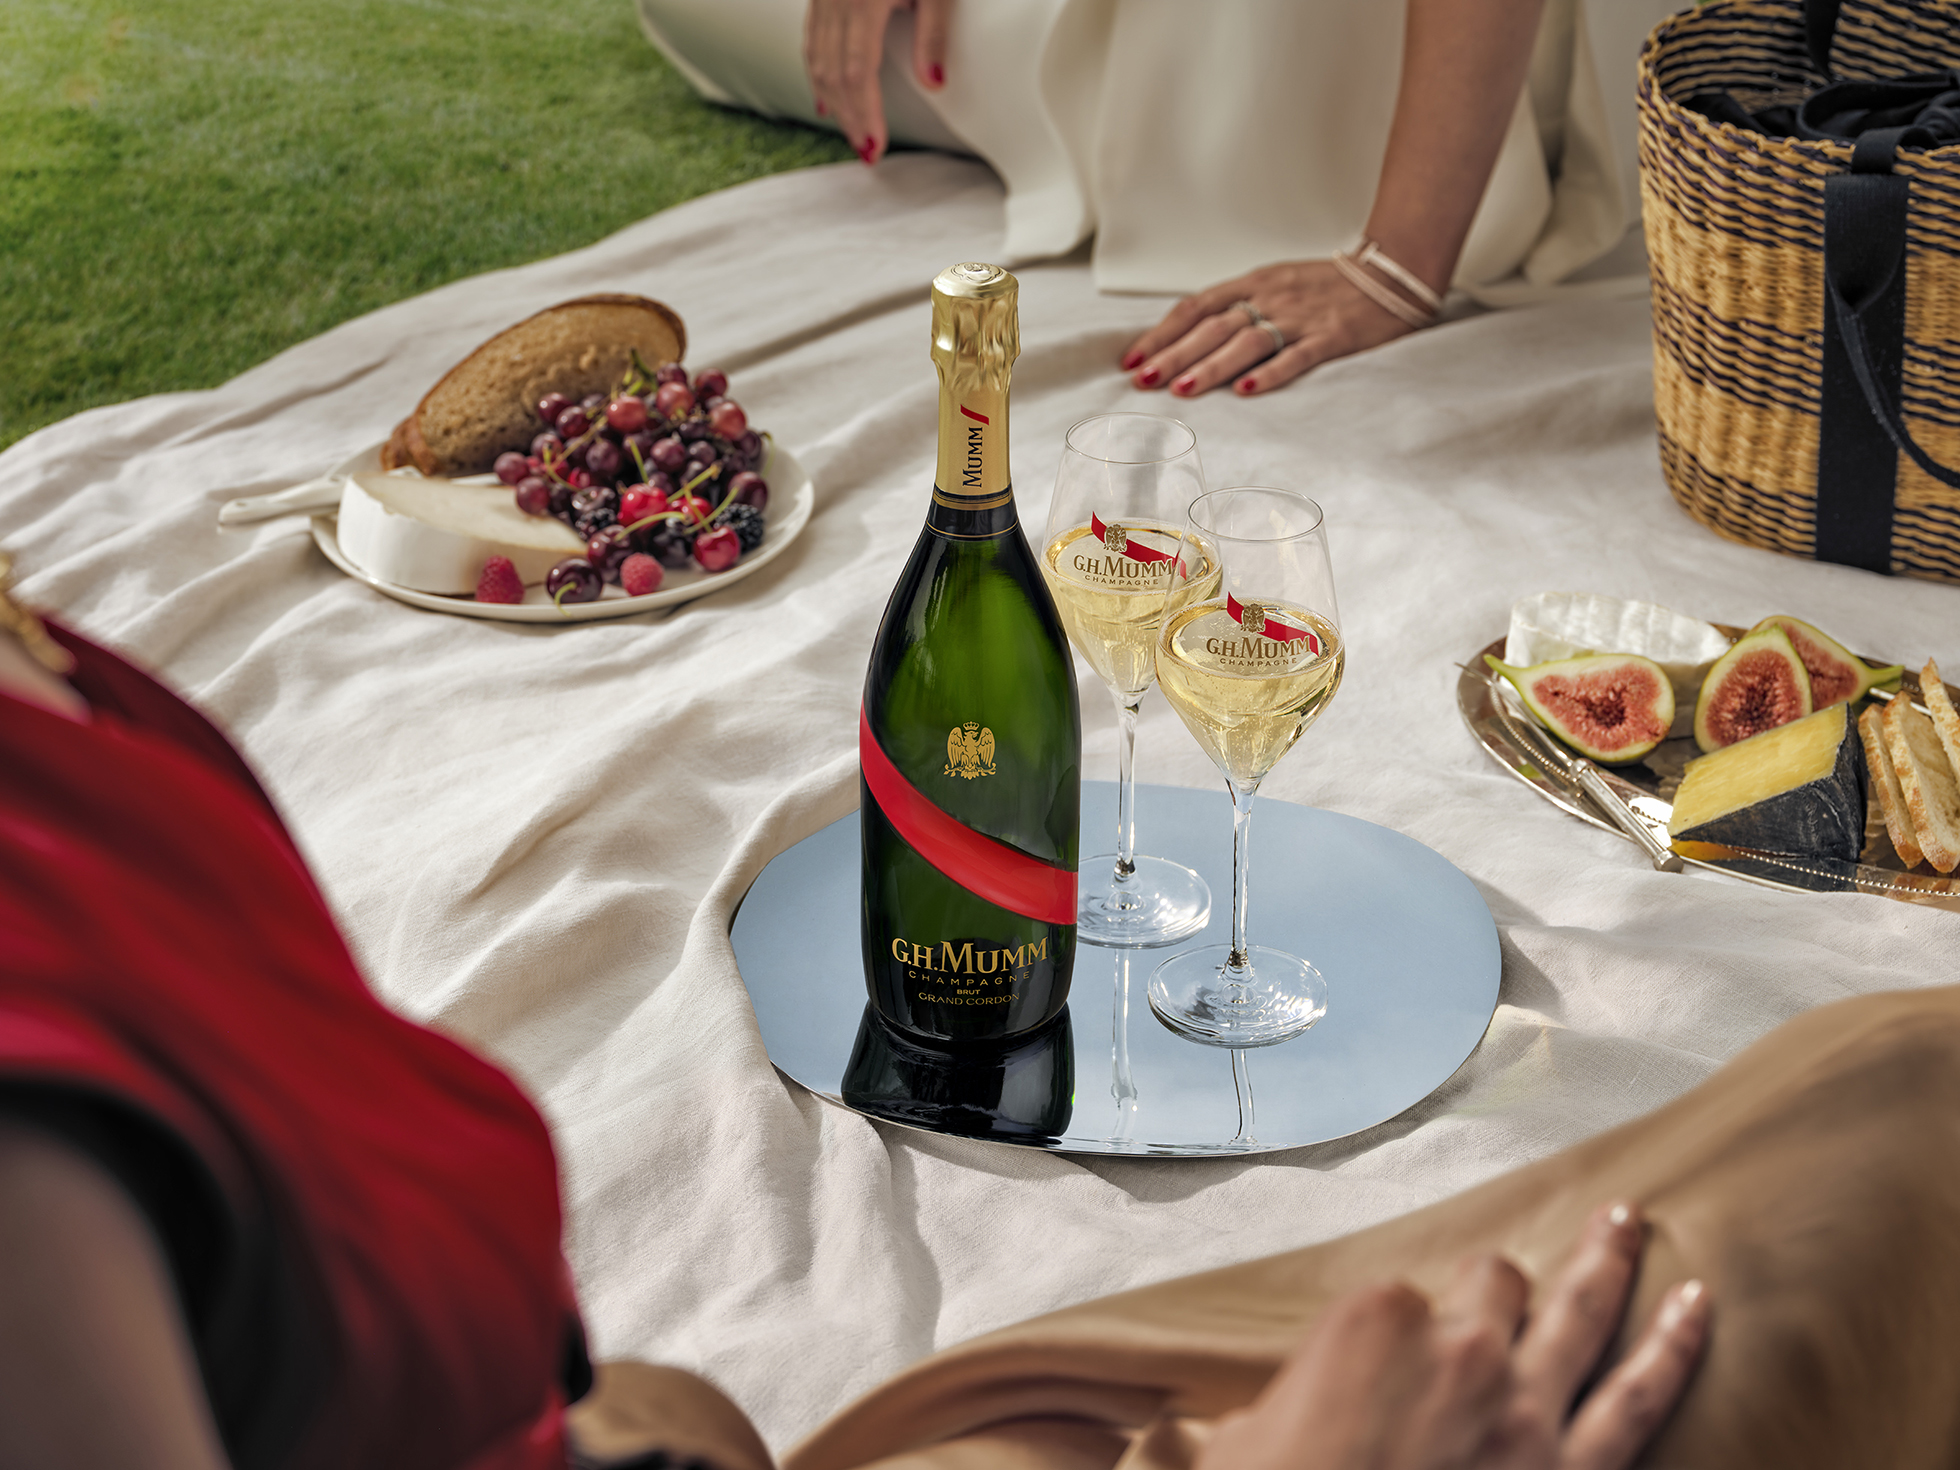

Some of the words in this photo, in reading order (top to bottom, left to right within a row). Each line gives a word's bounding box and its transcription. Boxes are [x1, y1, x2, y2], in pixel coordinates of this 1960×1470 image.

[962, 427, 983, 488] MUMM
[1084, 574, 1159, 586] CHAMPAGNE
[1220, 657, 1298, 667] CHAMPAGNE
[908, 970, 1030, 986] CHAMPAGNE
[918, 992, 963, 1006] GRAND
[965, 993, 1020, 1006] CORDON
